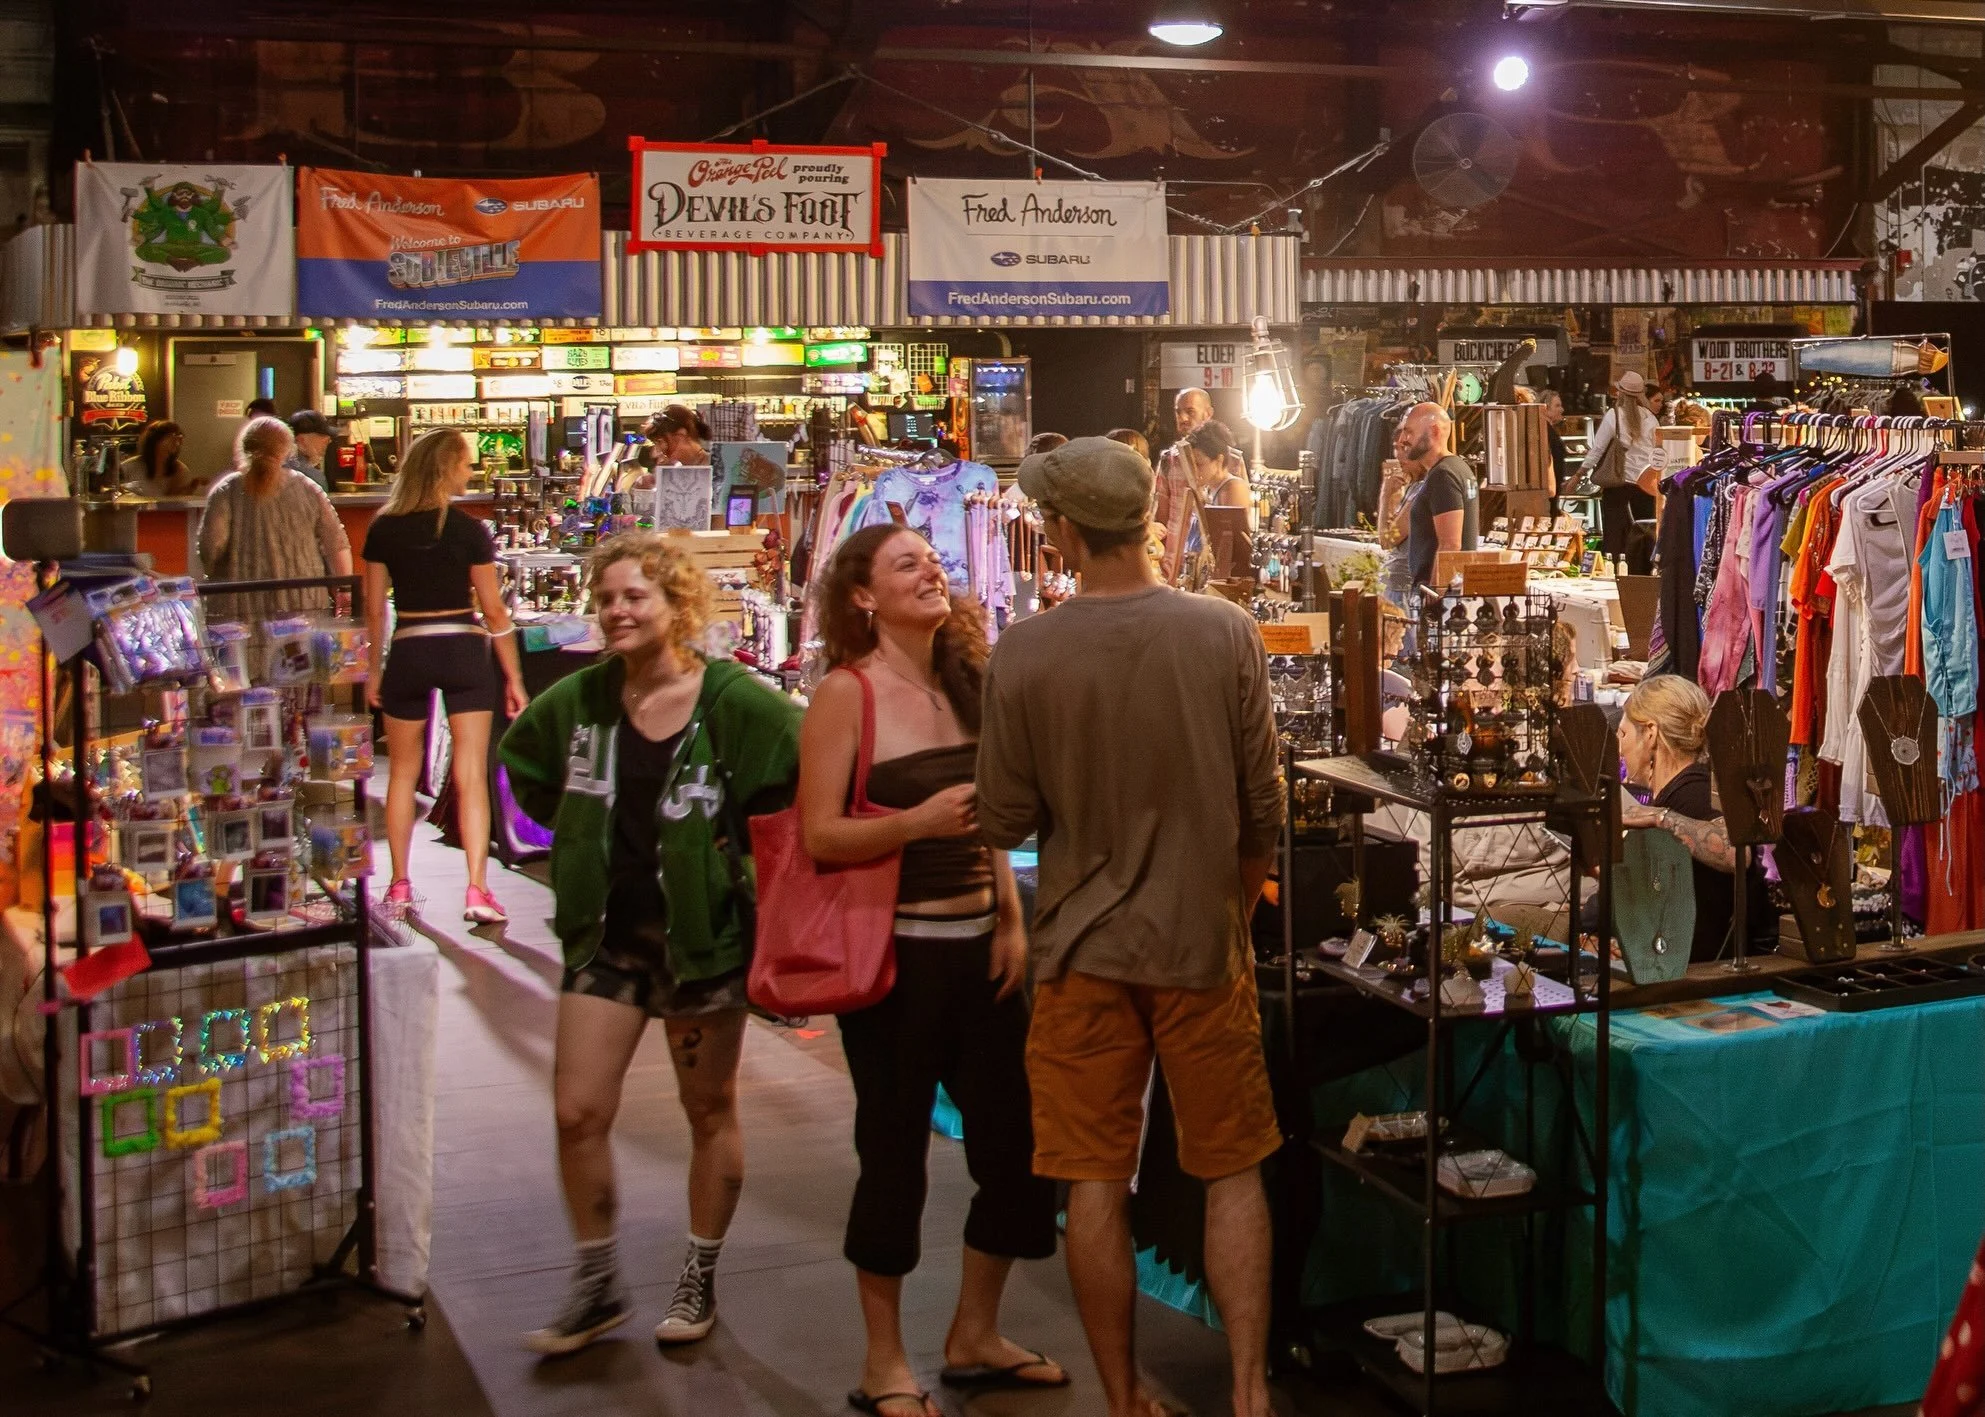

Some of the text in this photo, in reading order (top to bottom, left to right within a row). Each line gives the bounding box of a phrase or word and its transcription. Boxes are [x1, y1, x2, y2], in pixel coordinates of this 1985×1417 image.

[688, 156, 788, 187] Orange Peel
[793, 164, 844, 174] proudly
[798, 174, 849, 184] pouring
[319, 186, 445, 216] Fred Anderson
[512, 197, 585, 212] SUBARU
[780, 190, 865, 232] FOOT
[961, 193, 1118, 227] Fred Anderson
[390, 234, 462, 250] Welcome to
[665, 229, 844, 240] BEVERAGE COMPANY
[1025, 254, 1091, 265] SUBARU
[375, 299, 528, 311] FredAndersonSubaru.com
[948, 292, 1132, 305] FredAndersonSubaru.com
[1197, 344, 1235, 364] ELDER
[1698, 341, 1789, 359] WOOD BROTHERS
[1704, 361, 1733, 380] 8-21
[1735, 363, 1744, 376] &
[84, 390, 147, 403] Blue Ribbon
